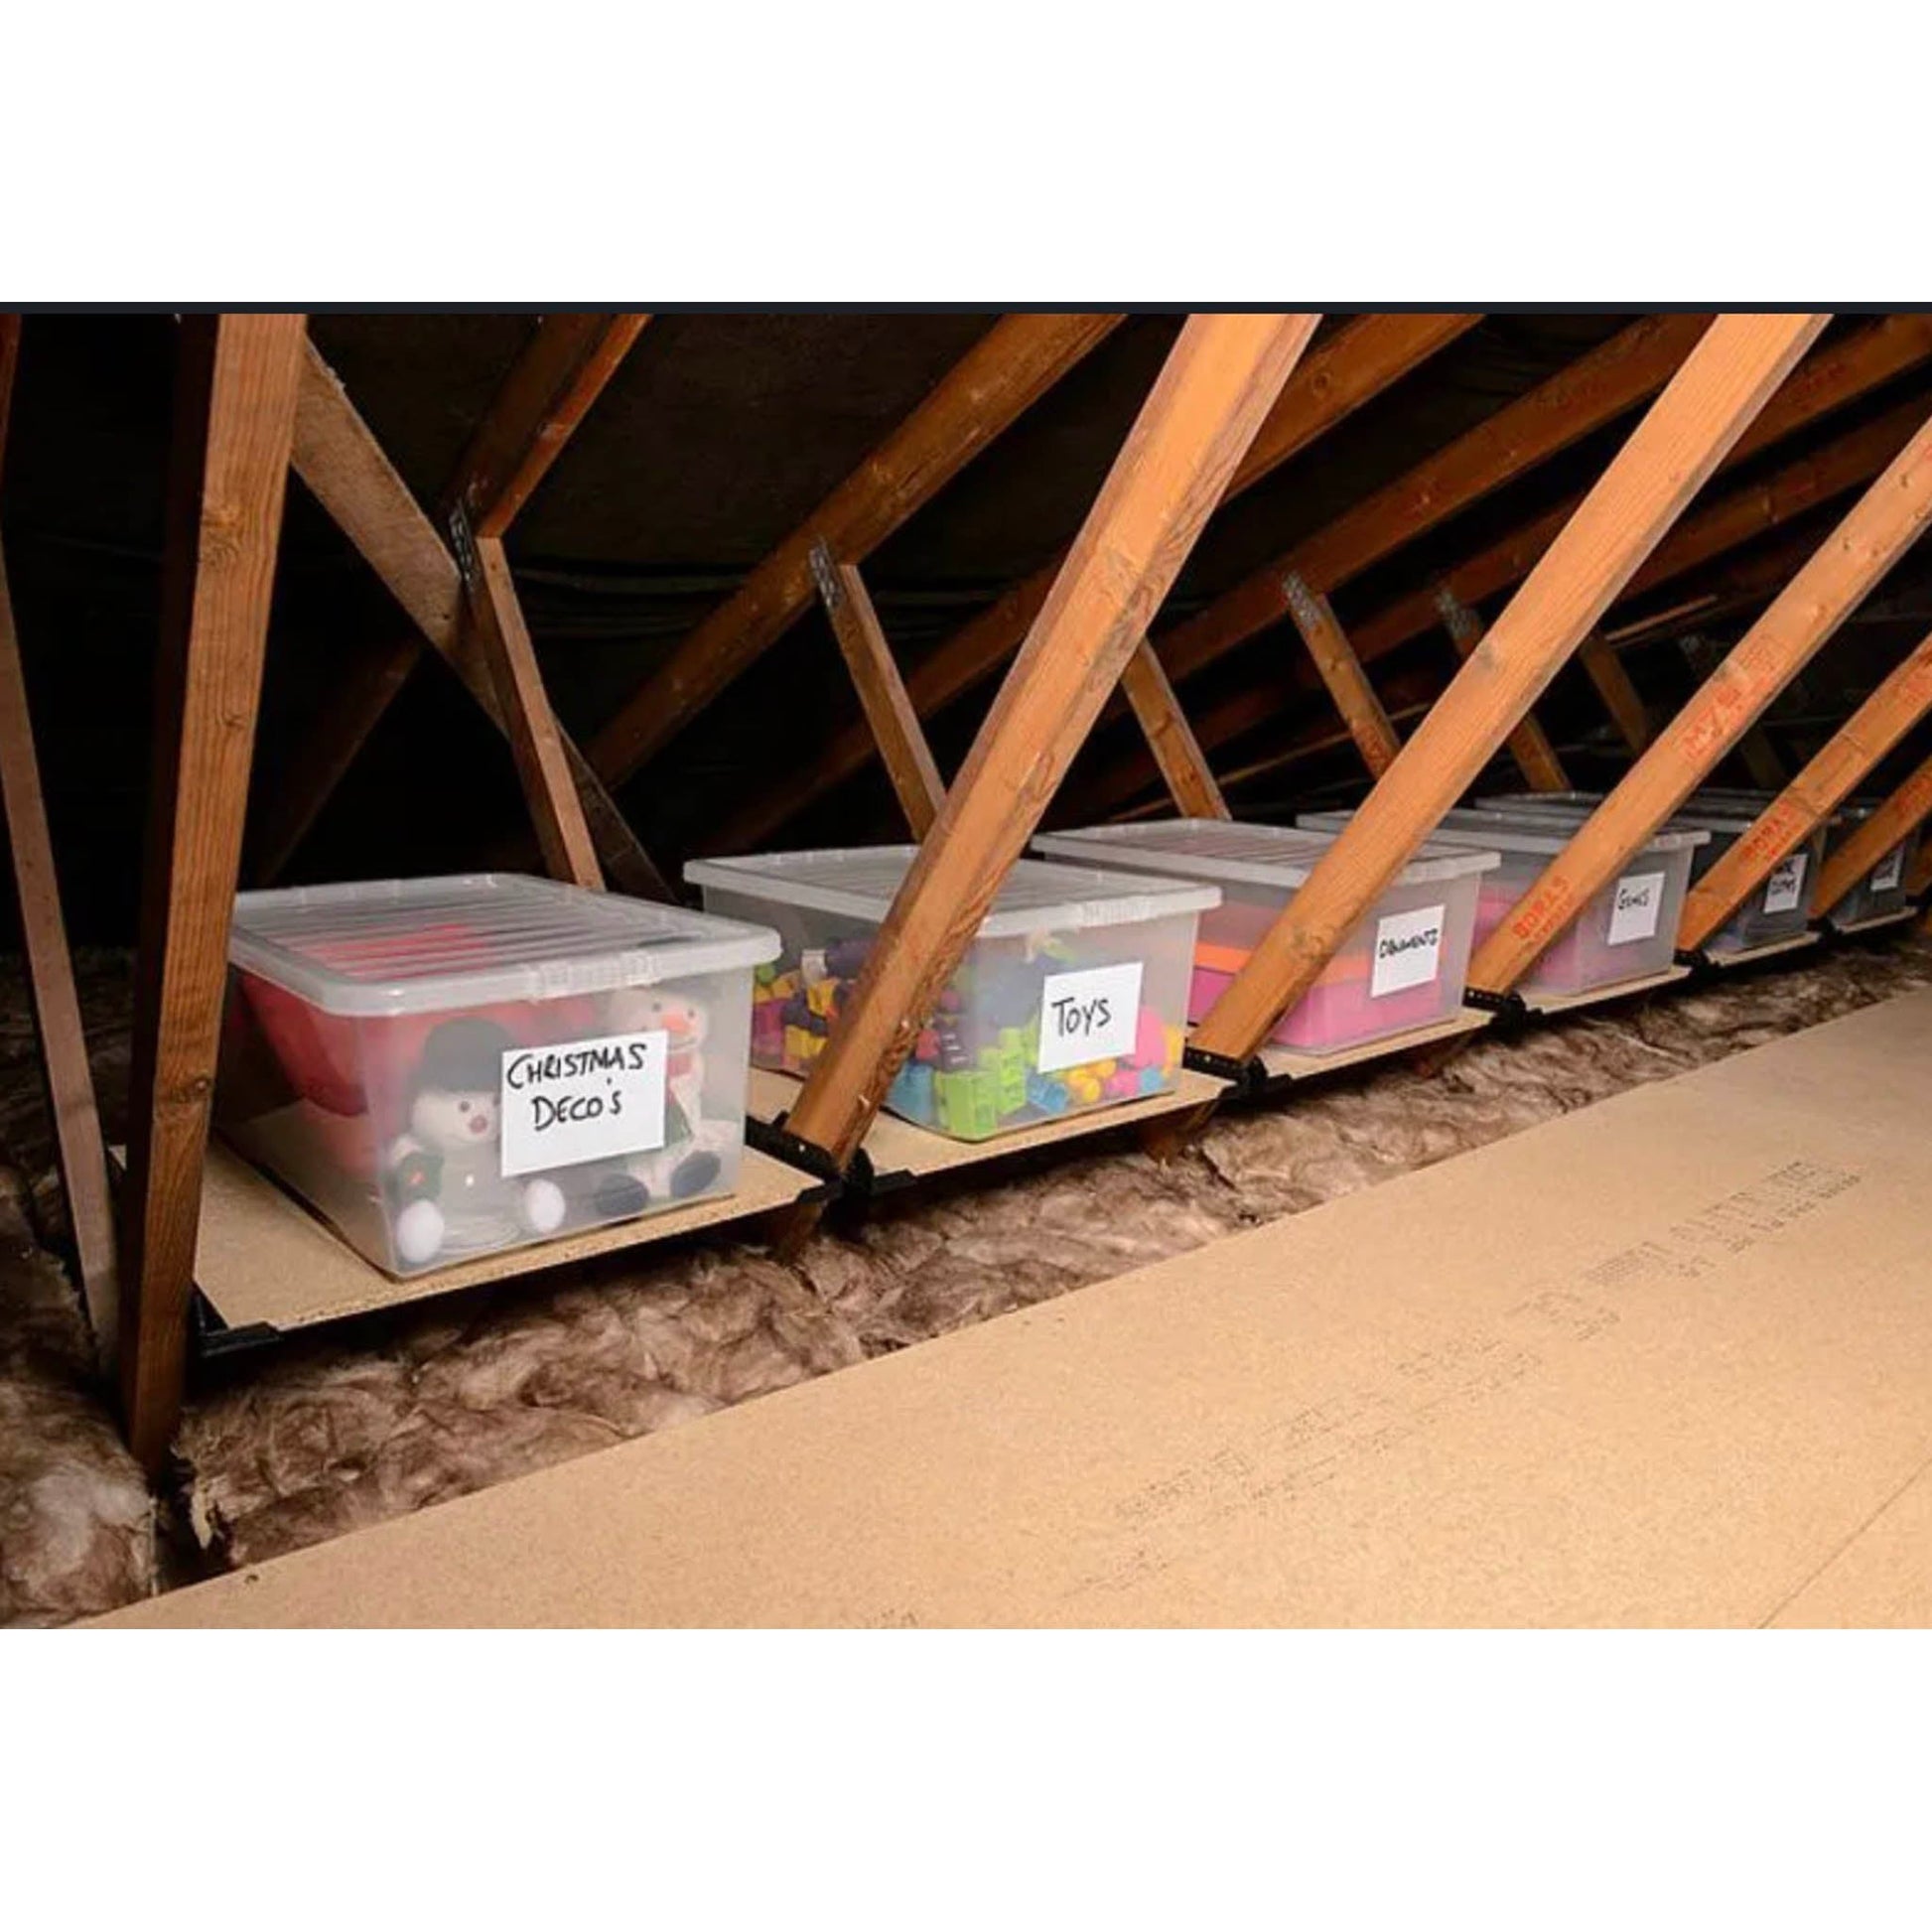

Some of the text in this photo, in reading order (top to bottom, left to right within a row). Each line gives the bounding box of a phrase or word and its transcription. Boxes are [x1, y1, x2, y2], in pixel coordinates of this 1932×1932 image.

[1050, 996, 1112, 1037] TOYS
[506, 1042, 647, 1090] CHRISTMAS
[531, 1076, 622, 1132] DECO'S
